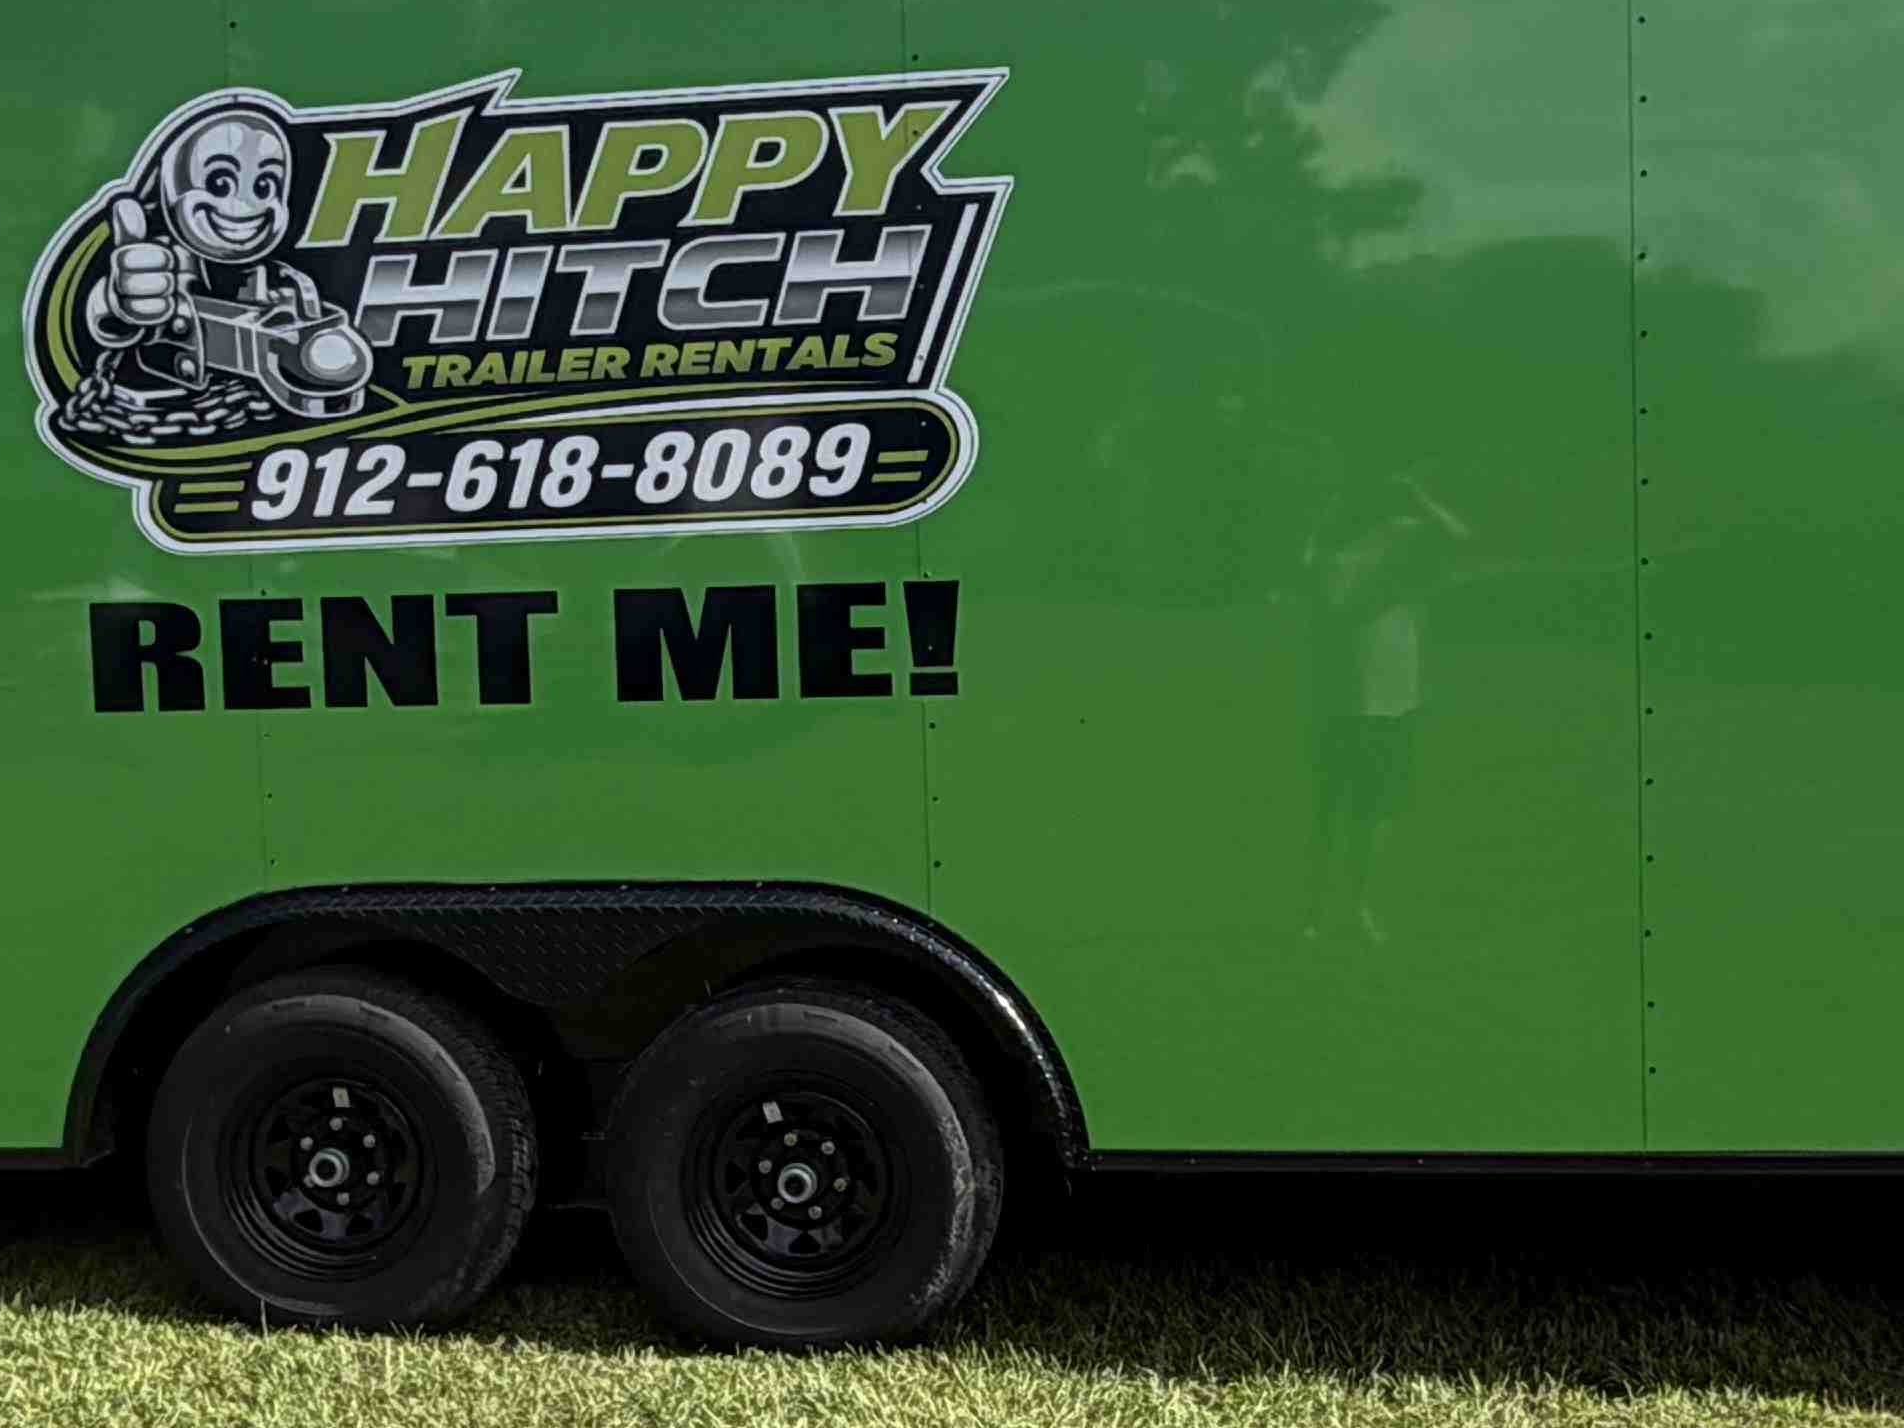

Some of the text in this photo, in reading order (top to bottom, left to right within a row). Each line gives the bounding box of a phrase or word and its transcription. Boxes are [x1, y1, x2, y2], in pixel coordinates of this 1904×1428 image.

[301, 100, 944, 250] HAPPY
[358, 224, 930, 346] HITCH
[401, 331, 897, 390] TRAILER RENTALS
[250, 422, 871, 521] 912-618-8089
[88, 579, 961, 714] RENT ME!
